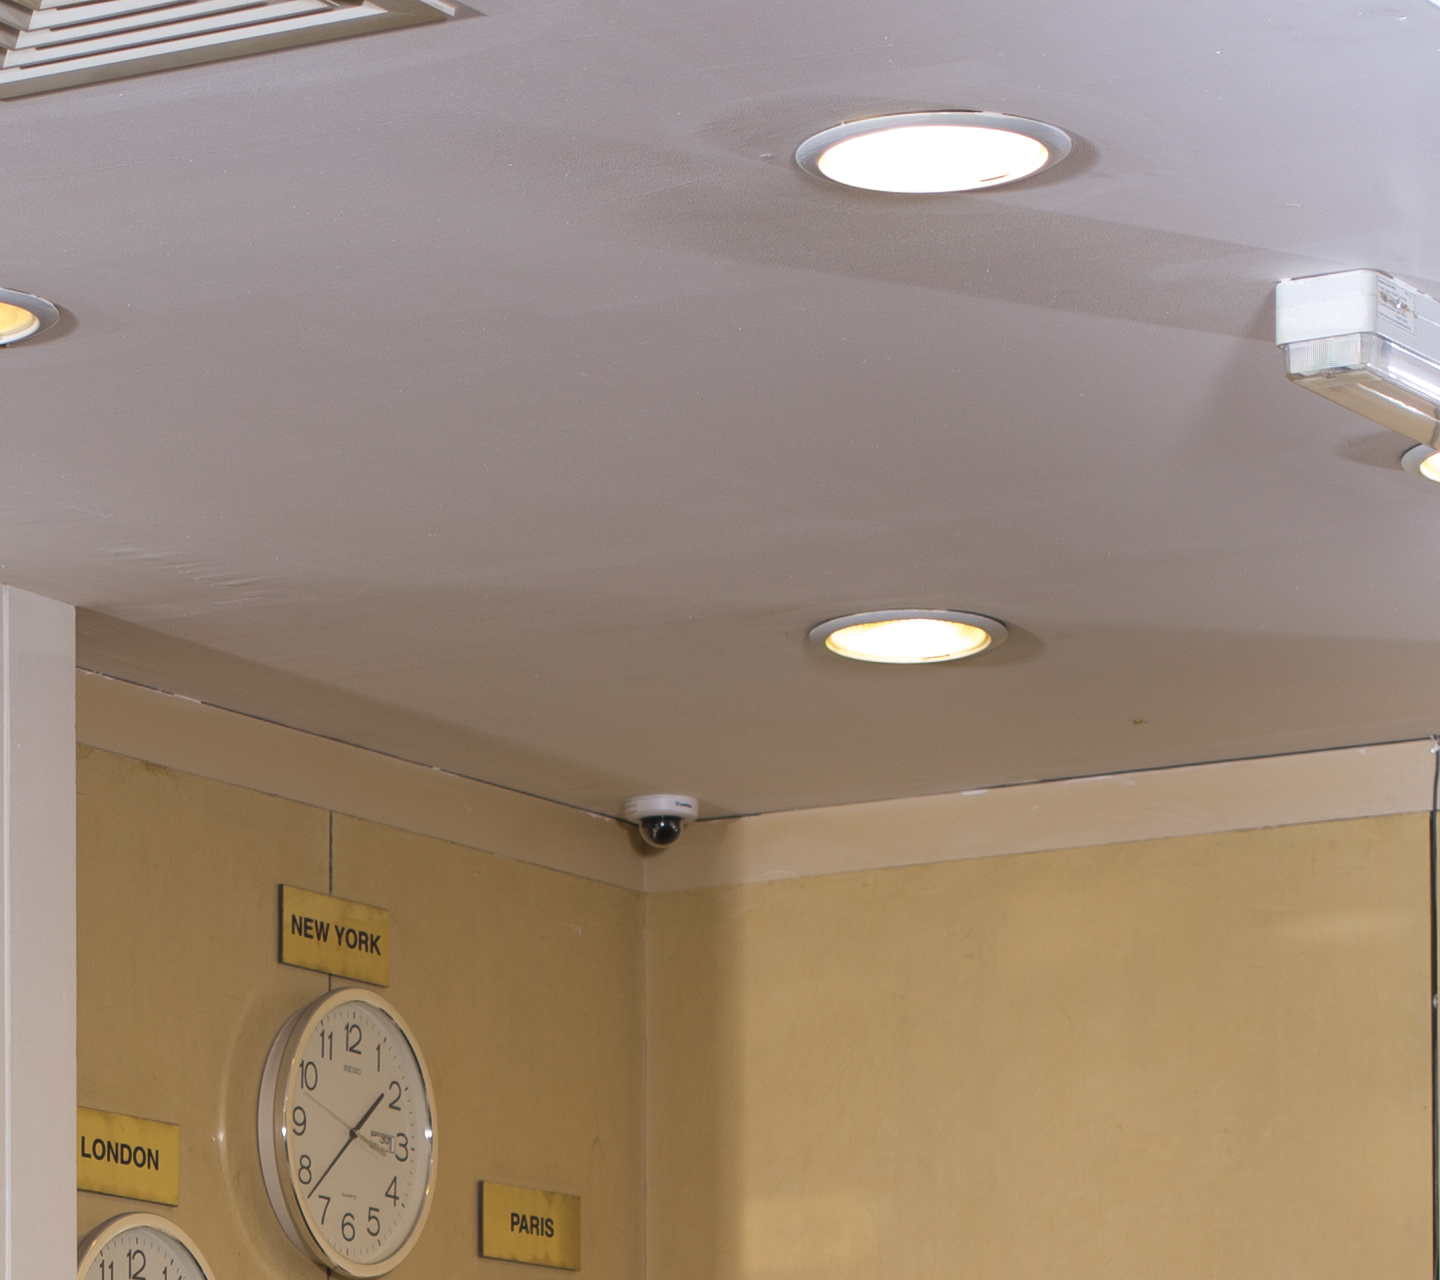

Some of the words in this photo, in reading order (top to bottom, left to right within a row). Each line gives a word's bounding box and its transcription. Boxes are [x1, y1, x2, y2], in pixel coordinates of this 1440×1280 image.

[291, 914, 330, 942] NEW
[334, 924, 382, 956] YORK
[320, 1030, 333, 1060] 11
[345, 1023, 362, 1054] 12
[376, 1044, 381, 1072] 1
[300, 1060, 318, 1090] 10
[389, 1081, 401, 1111] 2
[293, 1106, 306, 1136] 9
[80, 1138, 160, 1172] LONDON
[395, 1133, 408, 1162] 3
[298, 1155, 312, 1184] 8
[385, 1176, 399, 1207] 4
[319, 1195, 331, 1225] 7
[367, 1207, 380, 1236] 5
[341, 1213, 355, 1242] 6
[510, 1213, 554, 1238] PARIS
[127, 1249, 146, 1280] 12
